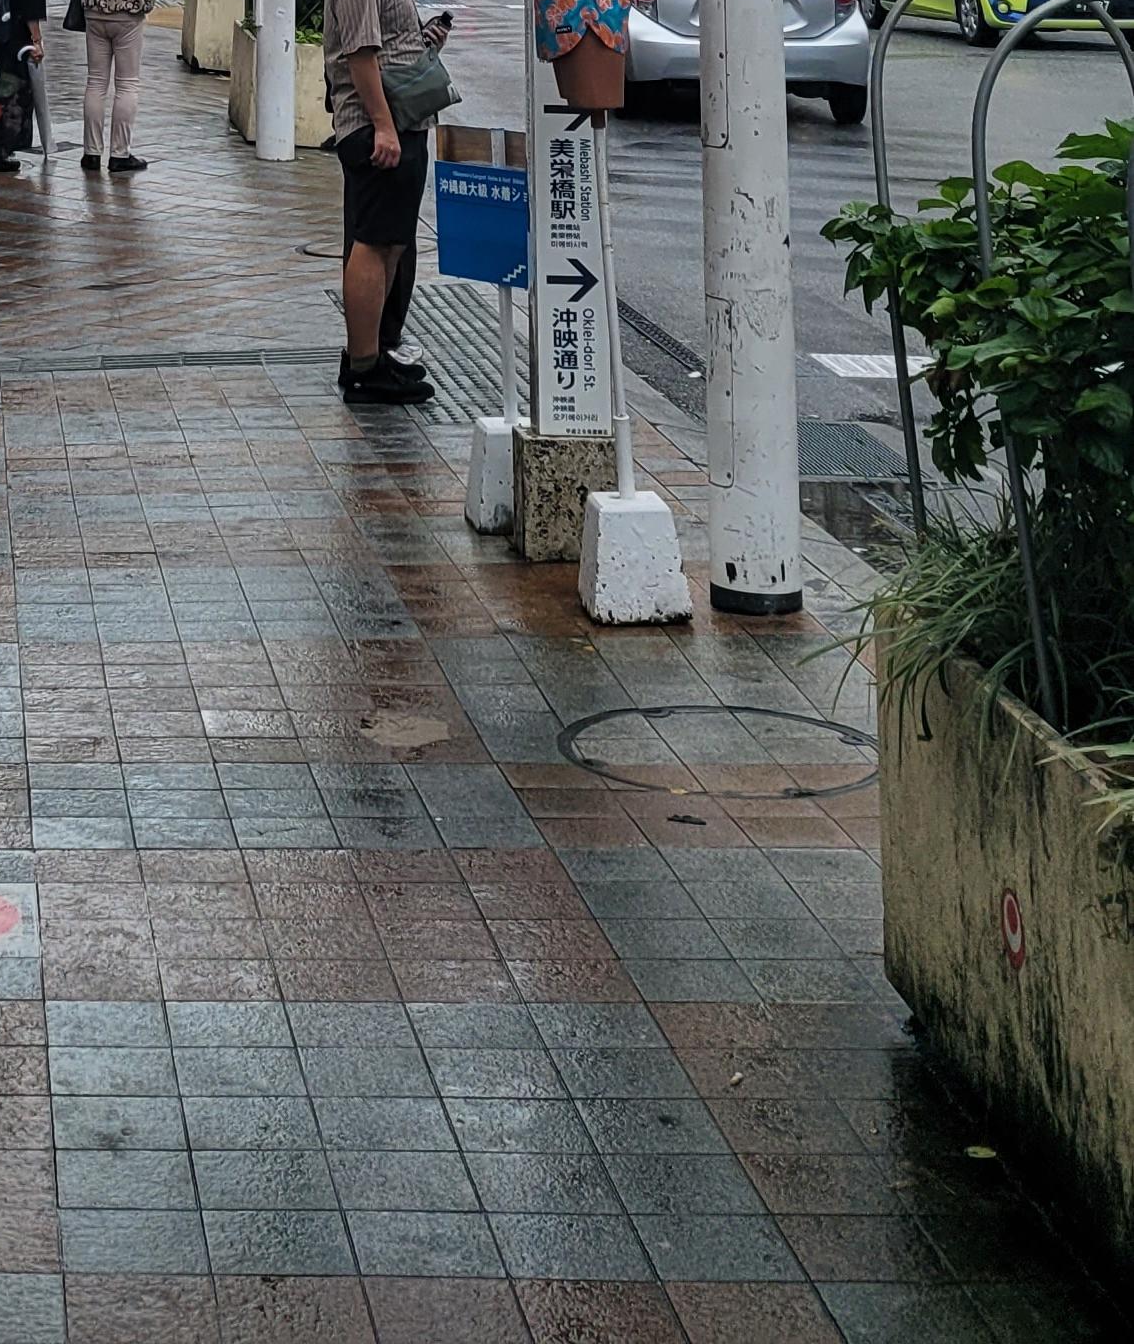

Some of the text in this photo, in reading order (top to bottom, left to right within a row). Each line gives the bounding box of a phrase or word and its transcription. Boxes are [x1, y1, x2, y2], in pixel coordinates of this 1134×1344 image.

[549, 138, 576, 221] 美栄橋駅
[579, 138, 593, 222] Miebashi Station
[552, 307, 580, 390] 沖映通り
[583, 374, 596, 392] St.
